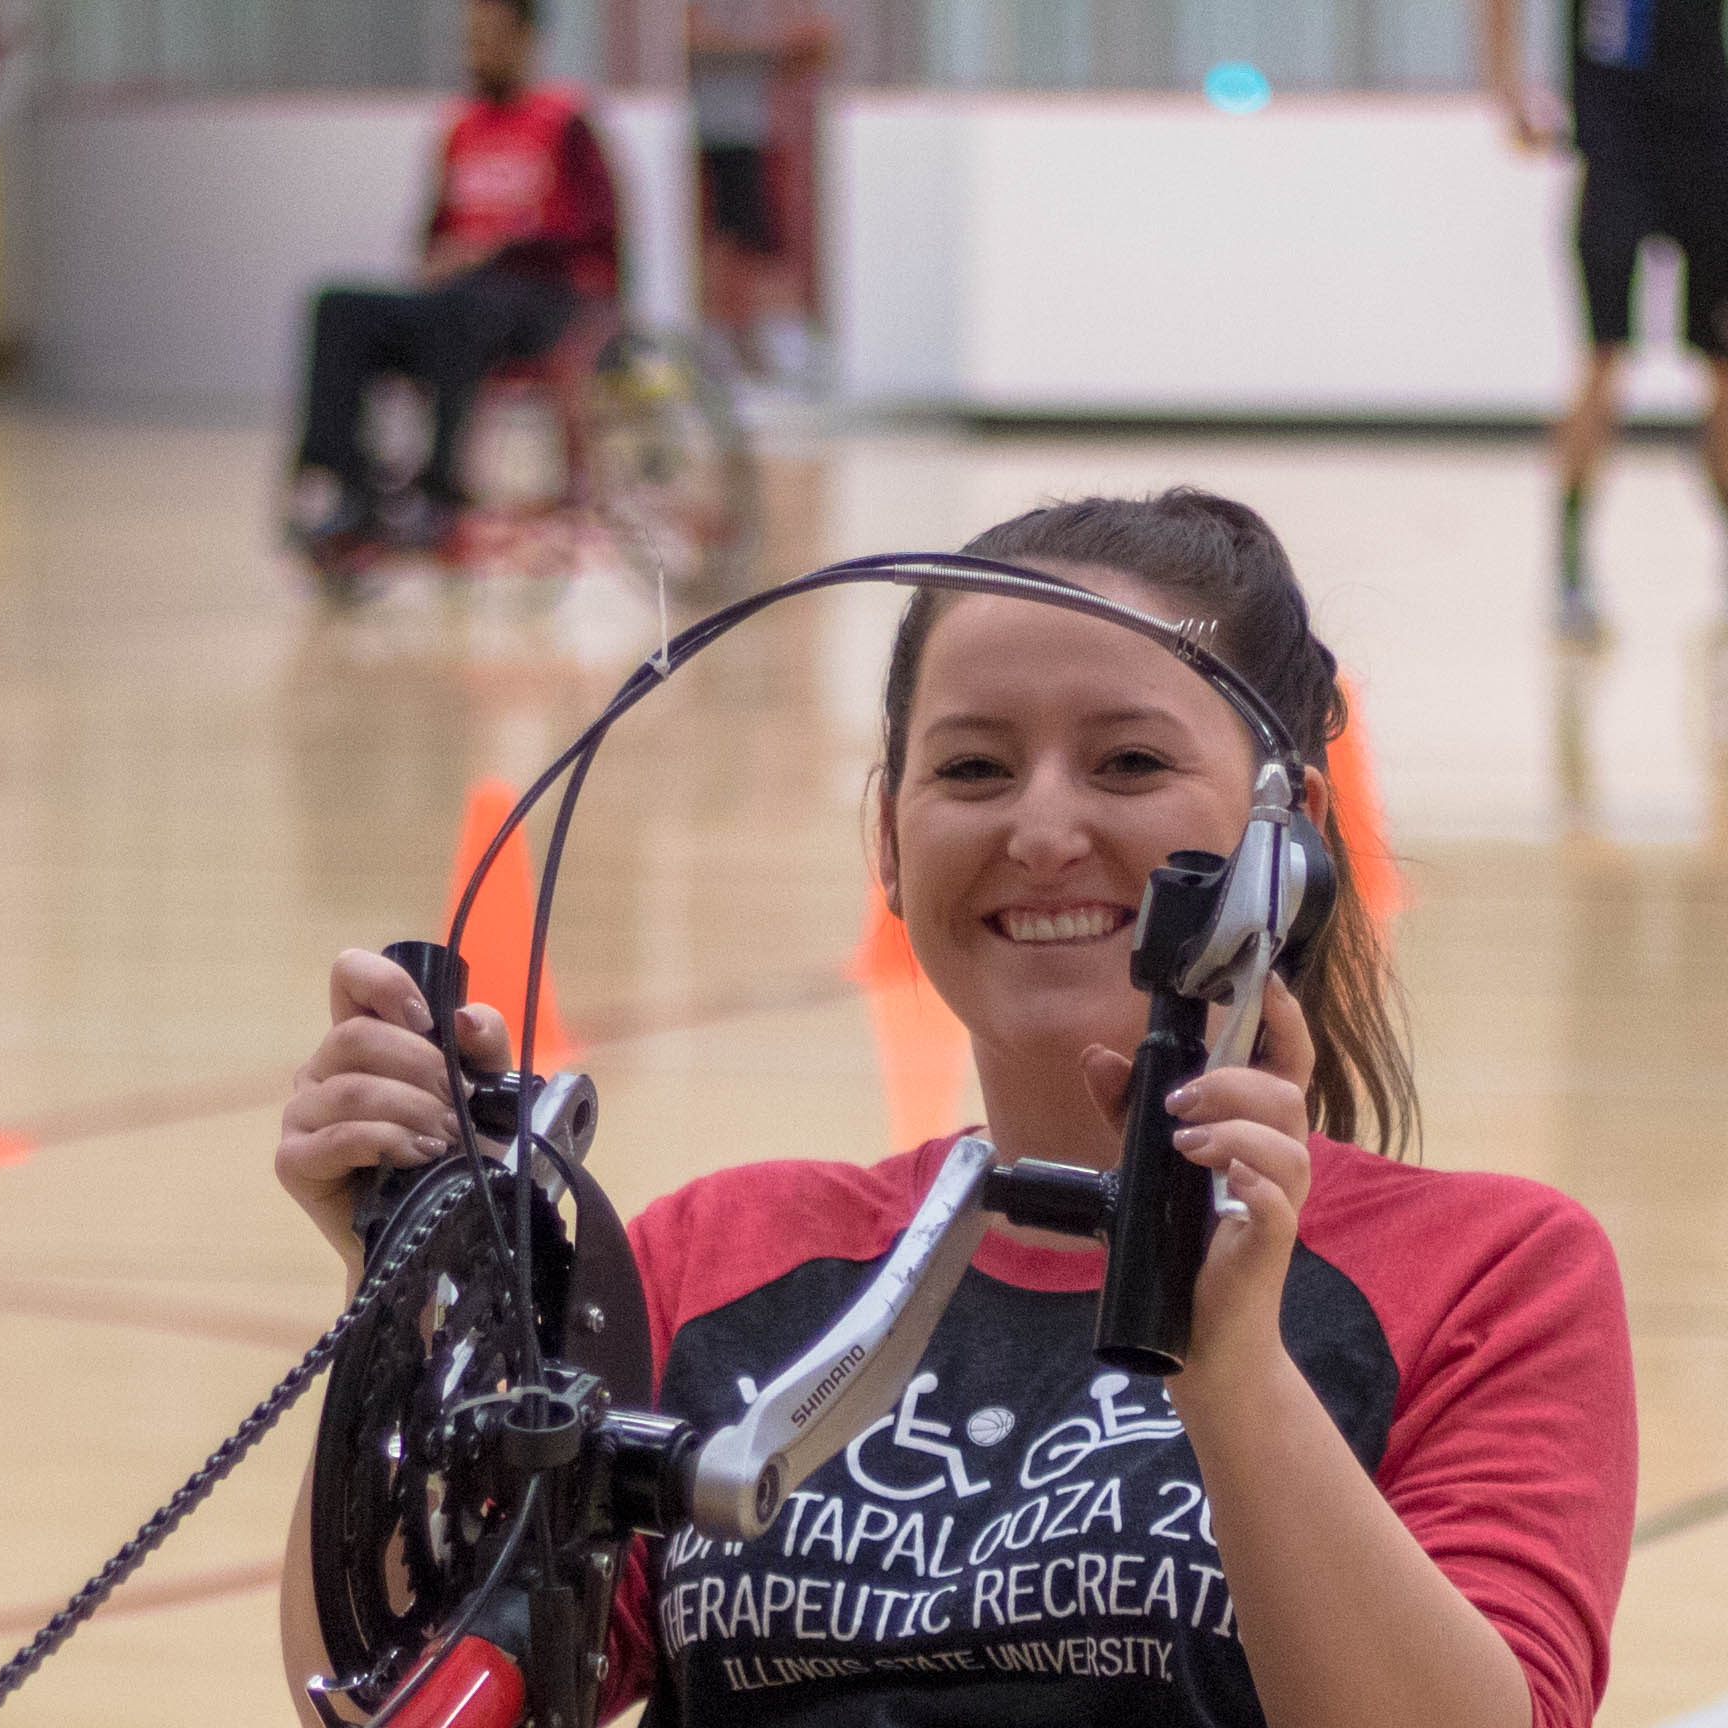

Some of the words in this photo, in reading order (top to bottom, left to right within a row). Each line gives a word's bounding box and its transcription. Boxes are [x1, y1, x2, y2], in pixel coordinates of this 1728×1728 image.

[791, 1344, 866, 1428] SHIMANO
[659, 1573, 959, 1660] THERAPEUTIC
[973, 1553, 1241, 1642] RECREATI
[723, 1654, 871, 1691] ILLINOIS
[874, 1650, 985, 1672] STATE
